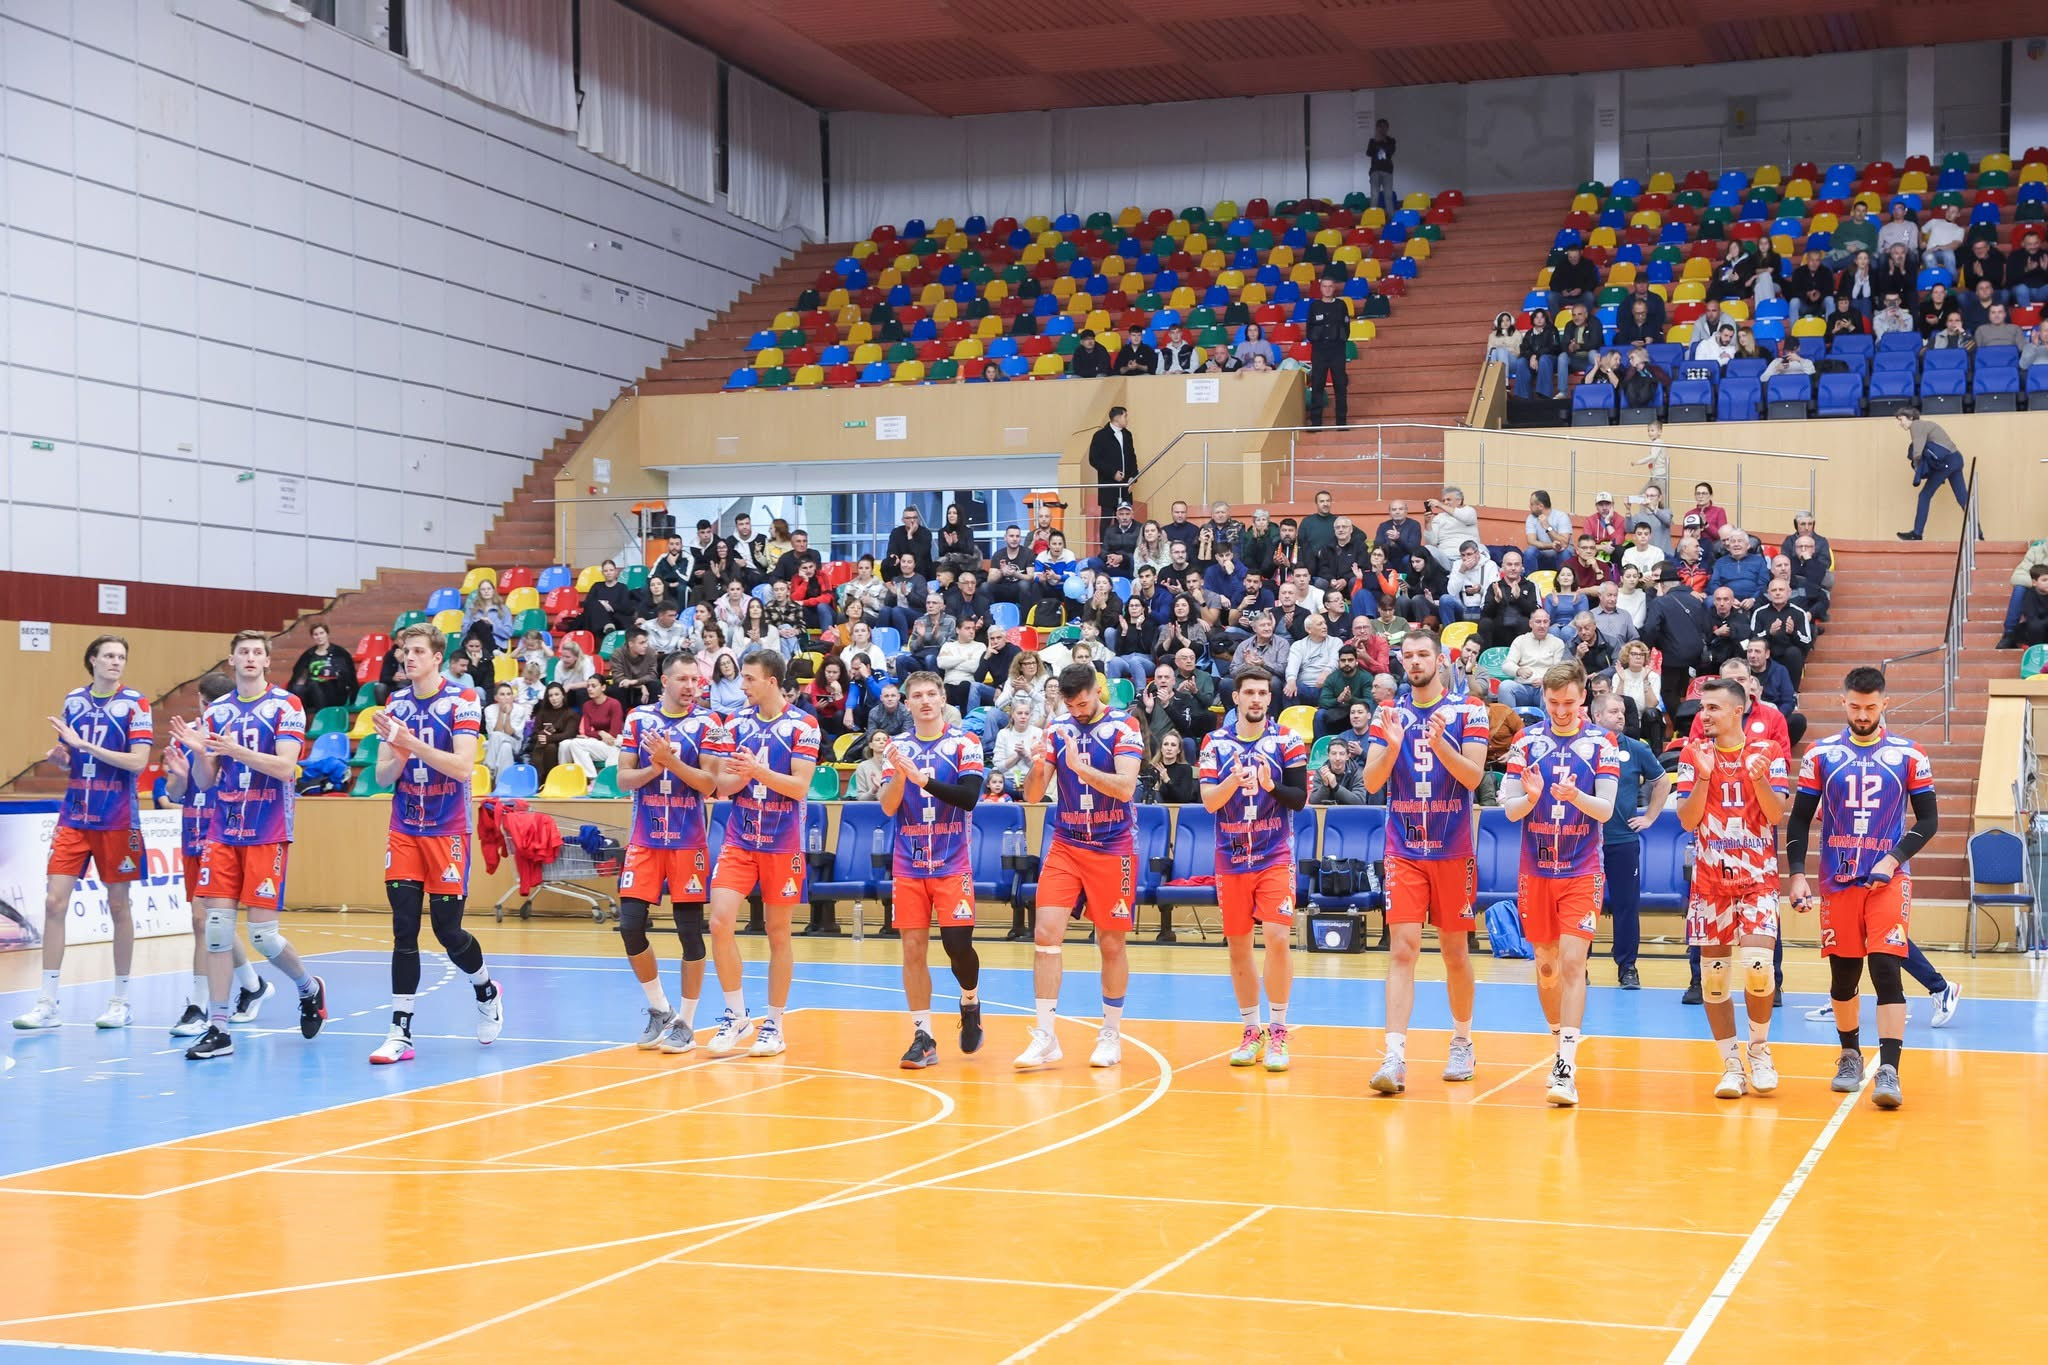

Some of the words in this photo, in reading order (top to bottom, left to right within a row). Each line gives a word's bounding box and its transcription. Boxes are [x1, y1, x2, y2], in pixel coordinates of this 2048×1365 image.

[21, 628, 49, 636] SECTOR
[32, 638, 39, 647] C
[79, 724, 109, 753] 17
[1414, 738, 1434, 772] 5
[1553, 765, 1571, 786] 7
[1719, 781, 1745, 807] 11
[1844, 774, 1884, 808] 12
[198, 867, 210, 886] 3
[1689, 916, 1709, 938] 11
